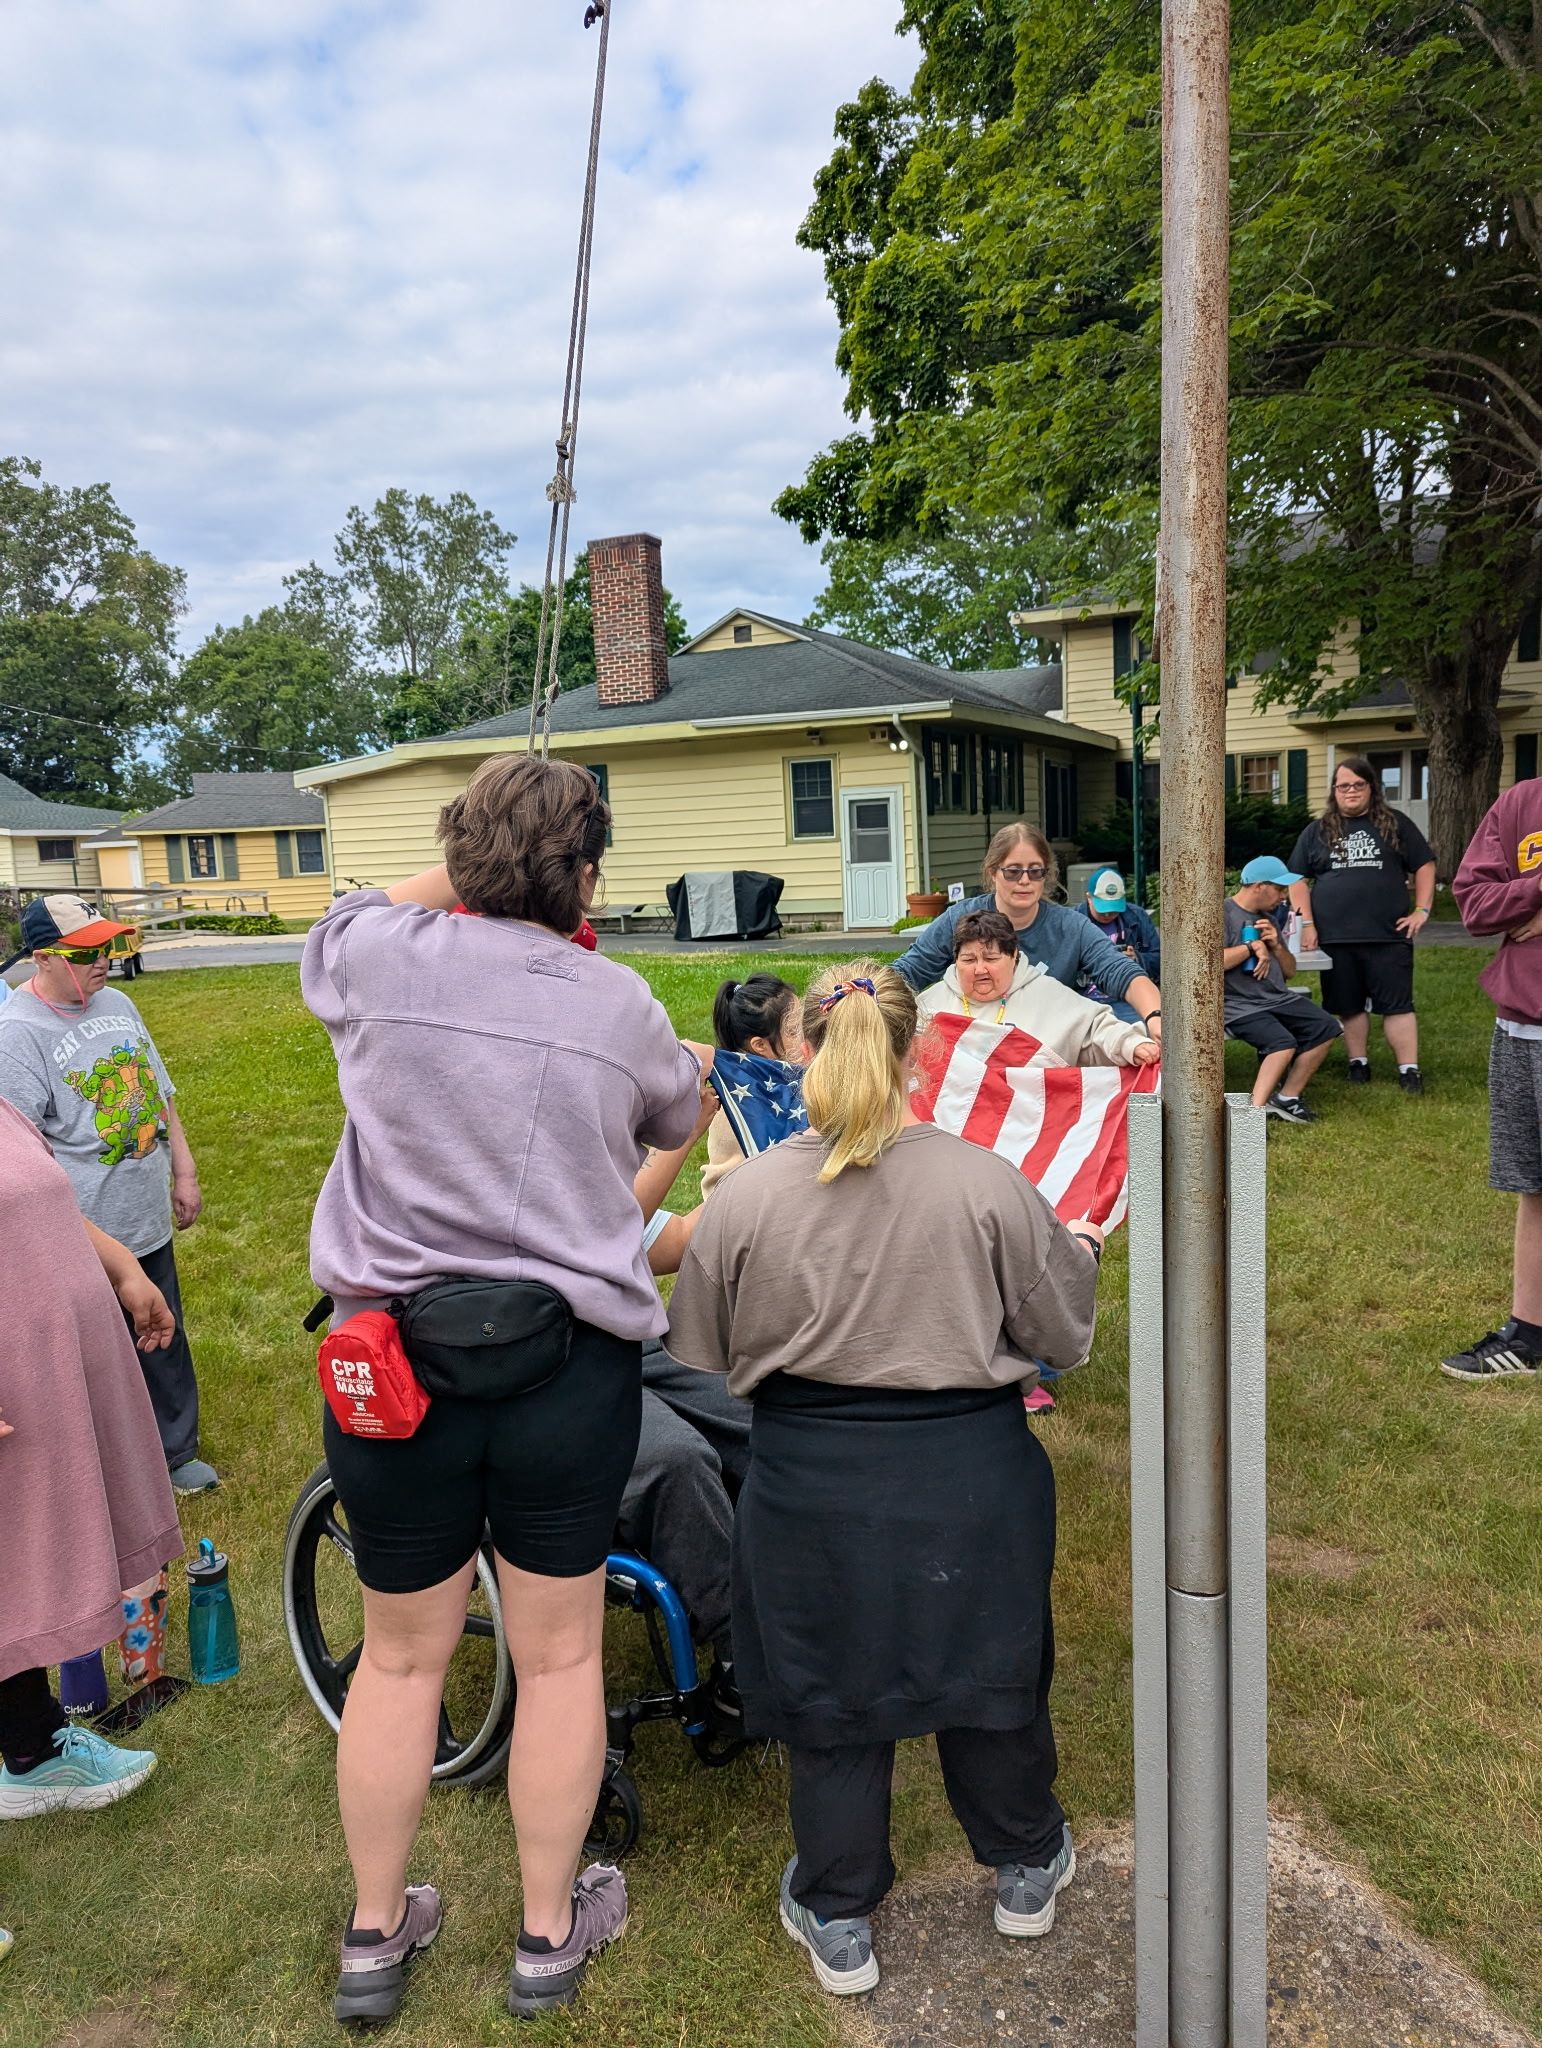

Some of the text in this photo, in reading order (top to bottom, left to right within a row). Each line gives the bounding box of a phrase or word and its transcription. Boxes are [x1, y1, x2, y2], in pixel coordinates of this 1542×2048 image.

[1347, 845, 1376, 859] ROCK
[1348, 860, 1383, 869] Elementary
[53, 1030, 81, 1070] SAY
[332, 1359, 373, 1379] CPR
[336, 1381, 377, 1397] MASK
[64, 1702, 92, 1714] Cirkul
[531, 1952, 584, 1976] SALOMON
